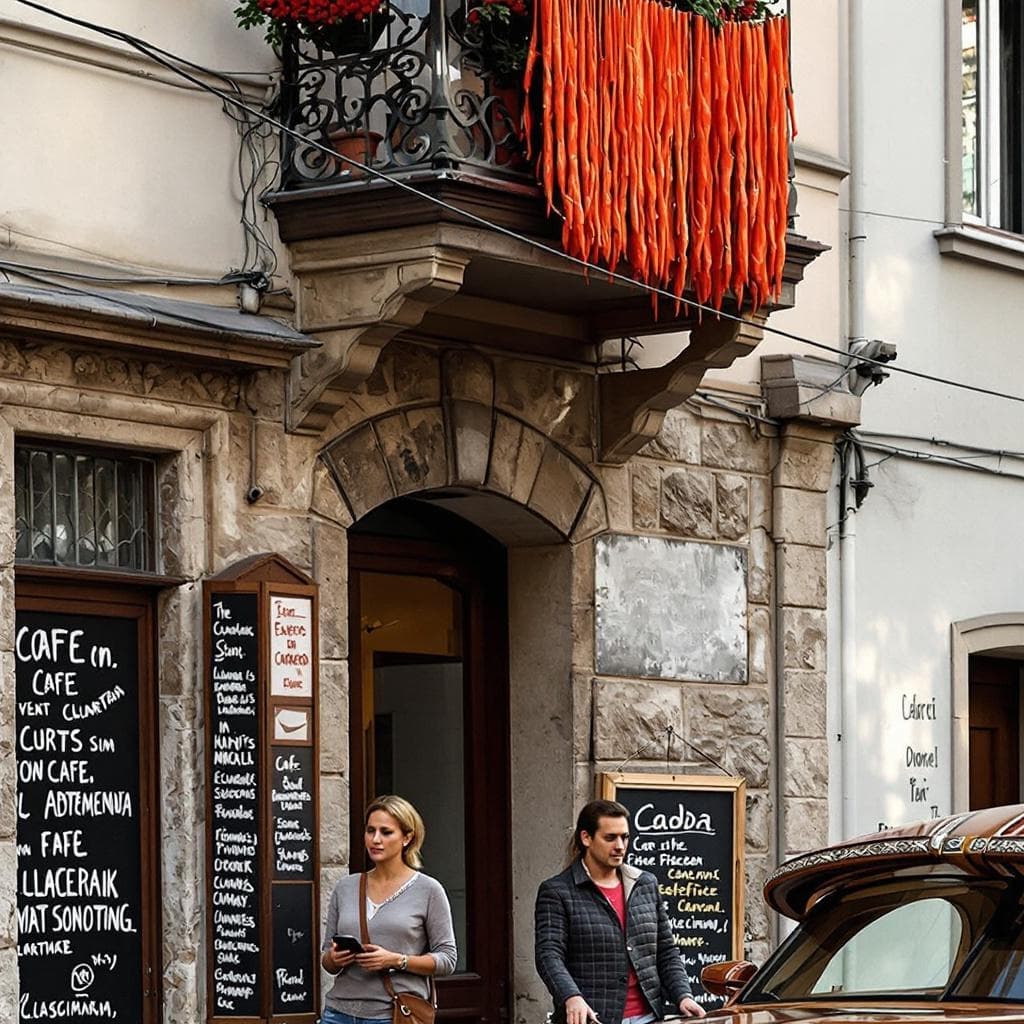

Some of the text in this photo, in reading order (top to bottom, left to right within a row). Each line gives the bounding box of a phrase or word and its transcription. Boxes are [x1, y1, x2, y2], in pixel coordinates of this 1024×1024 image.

[213, 601, 233, 619] The
[16, 626, 85, 664] CAFE
[32, 669, 79, 696] CAFE
[20, 725, 83, 753] CURTS
[40, 829, 88, 858] FAFE
